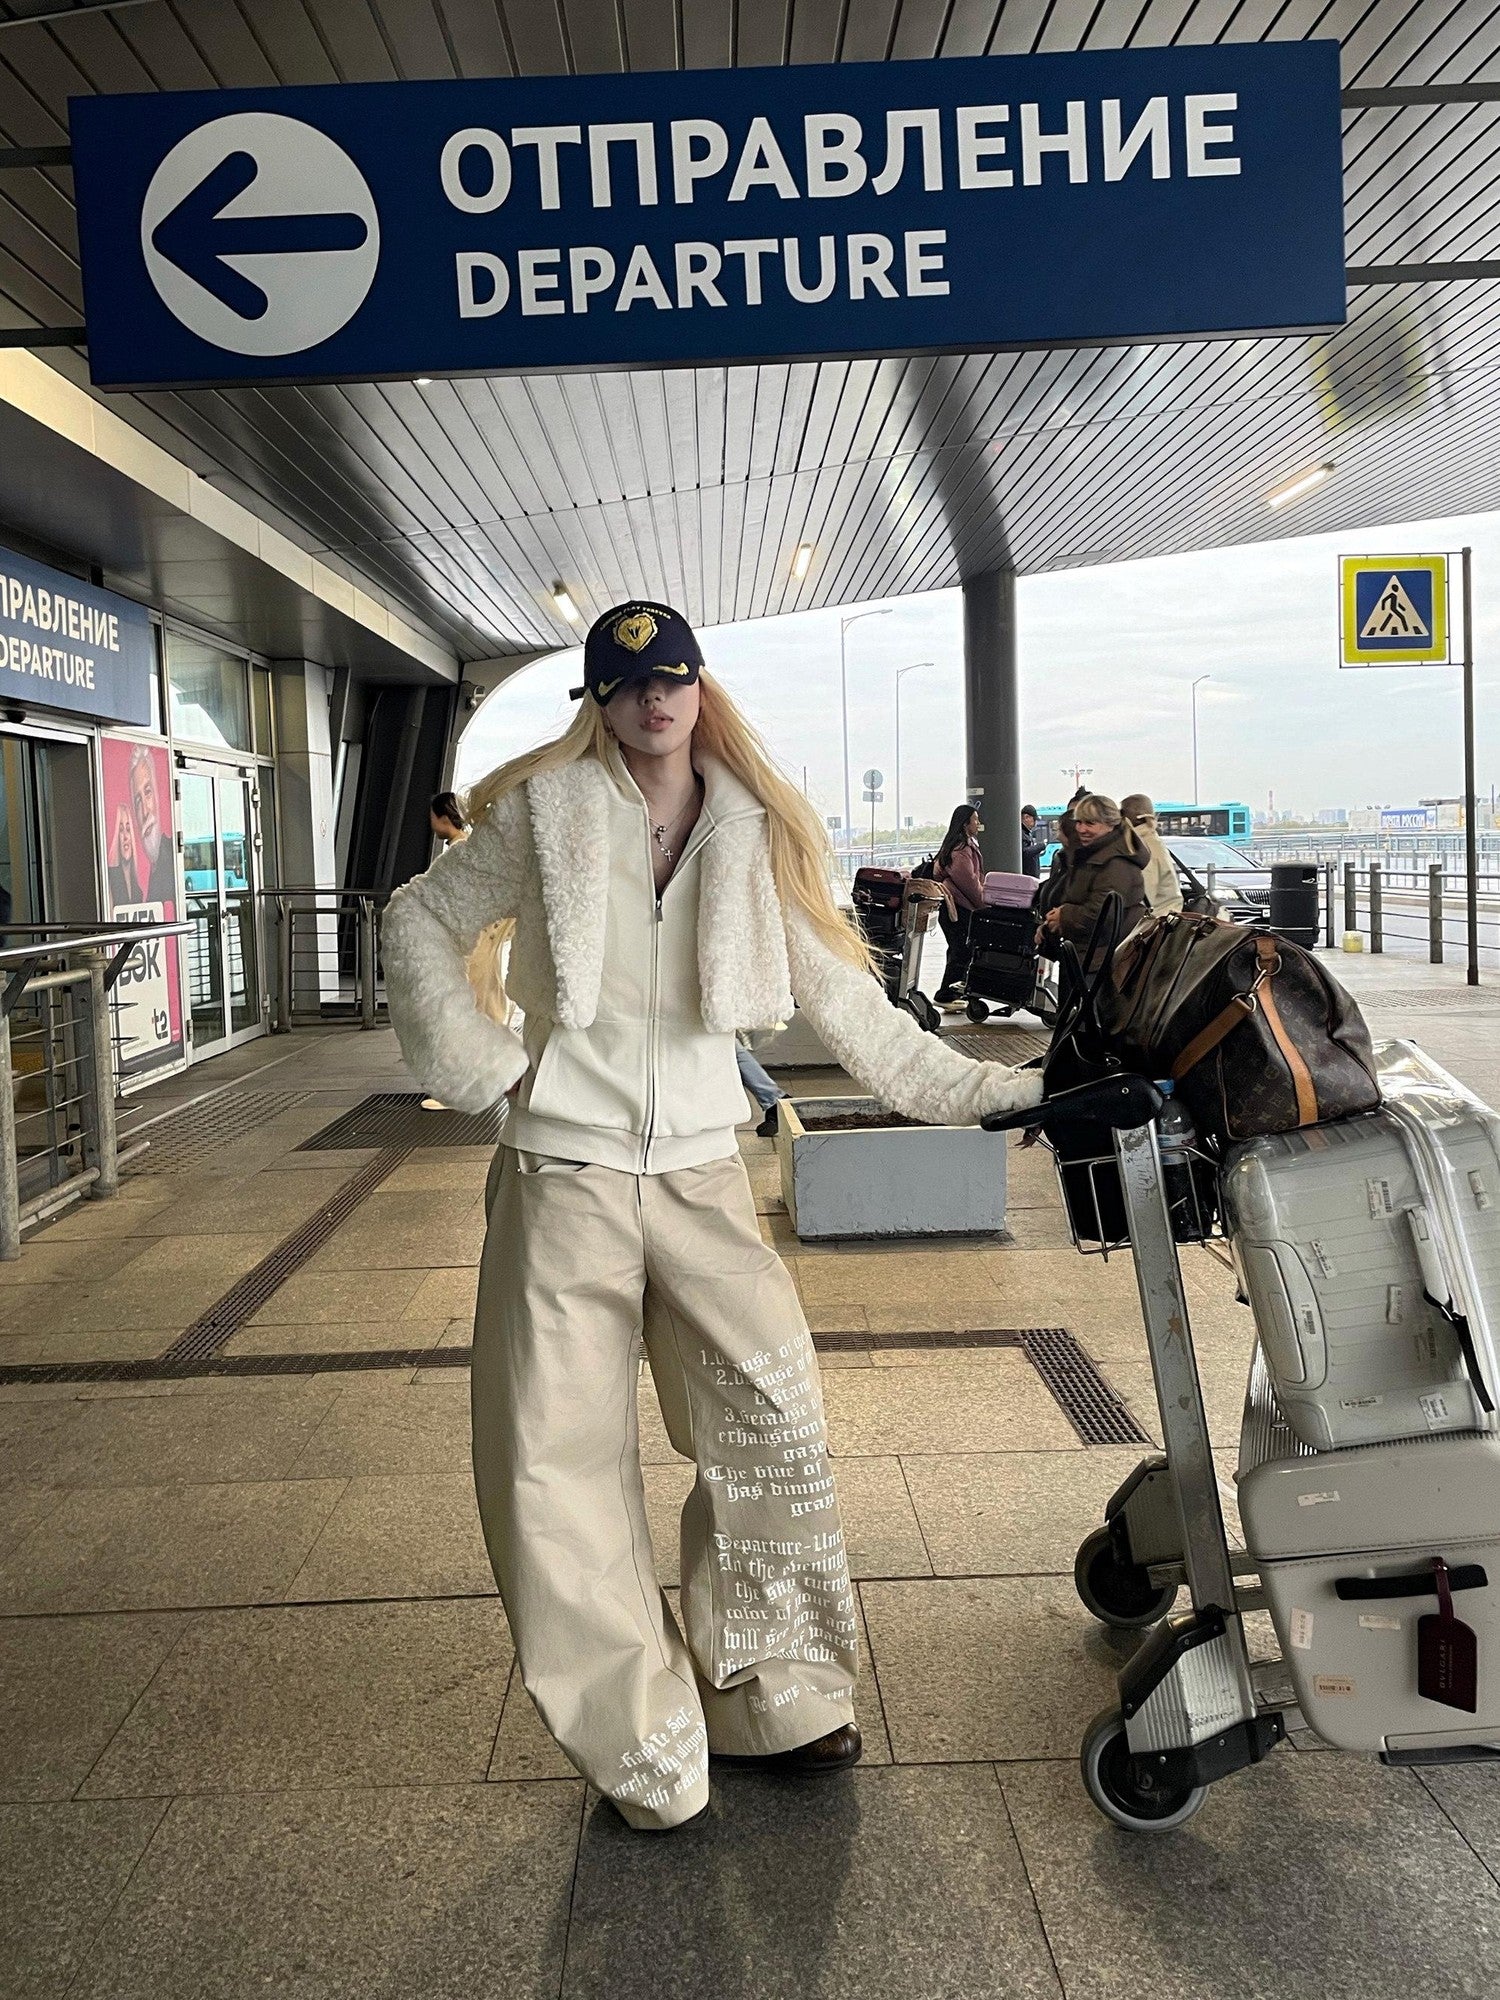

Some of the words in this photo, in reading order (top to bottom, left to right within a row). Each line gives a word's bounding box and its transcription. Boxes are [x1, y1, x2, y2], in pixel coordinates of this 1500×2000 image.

[440, 93, 1241, 213] ОТПРАВЛЕНИЕ
[456, 229, 950, 318] DEPARTURE
[803, 1459, 822, 1477] of
[726, 1482, 763, 1502] has
[770, 1475, 835, 1496] dimme
[748, 1557, 775, 1583] the
